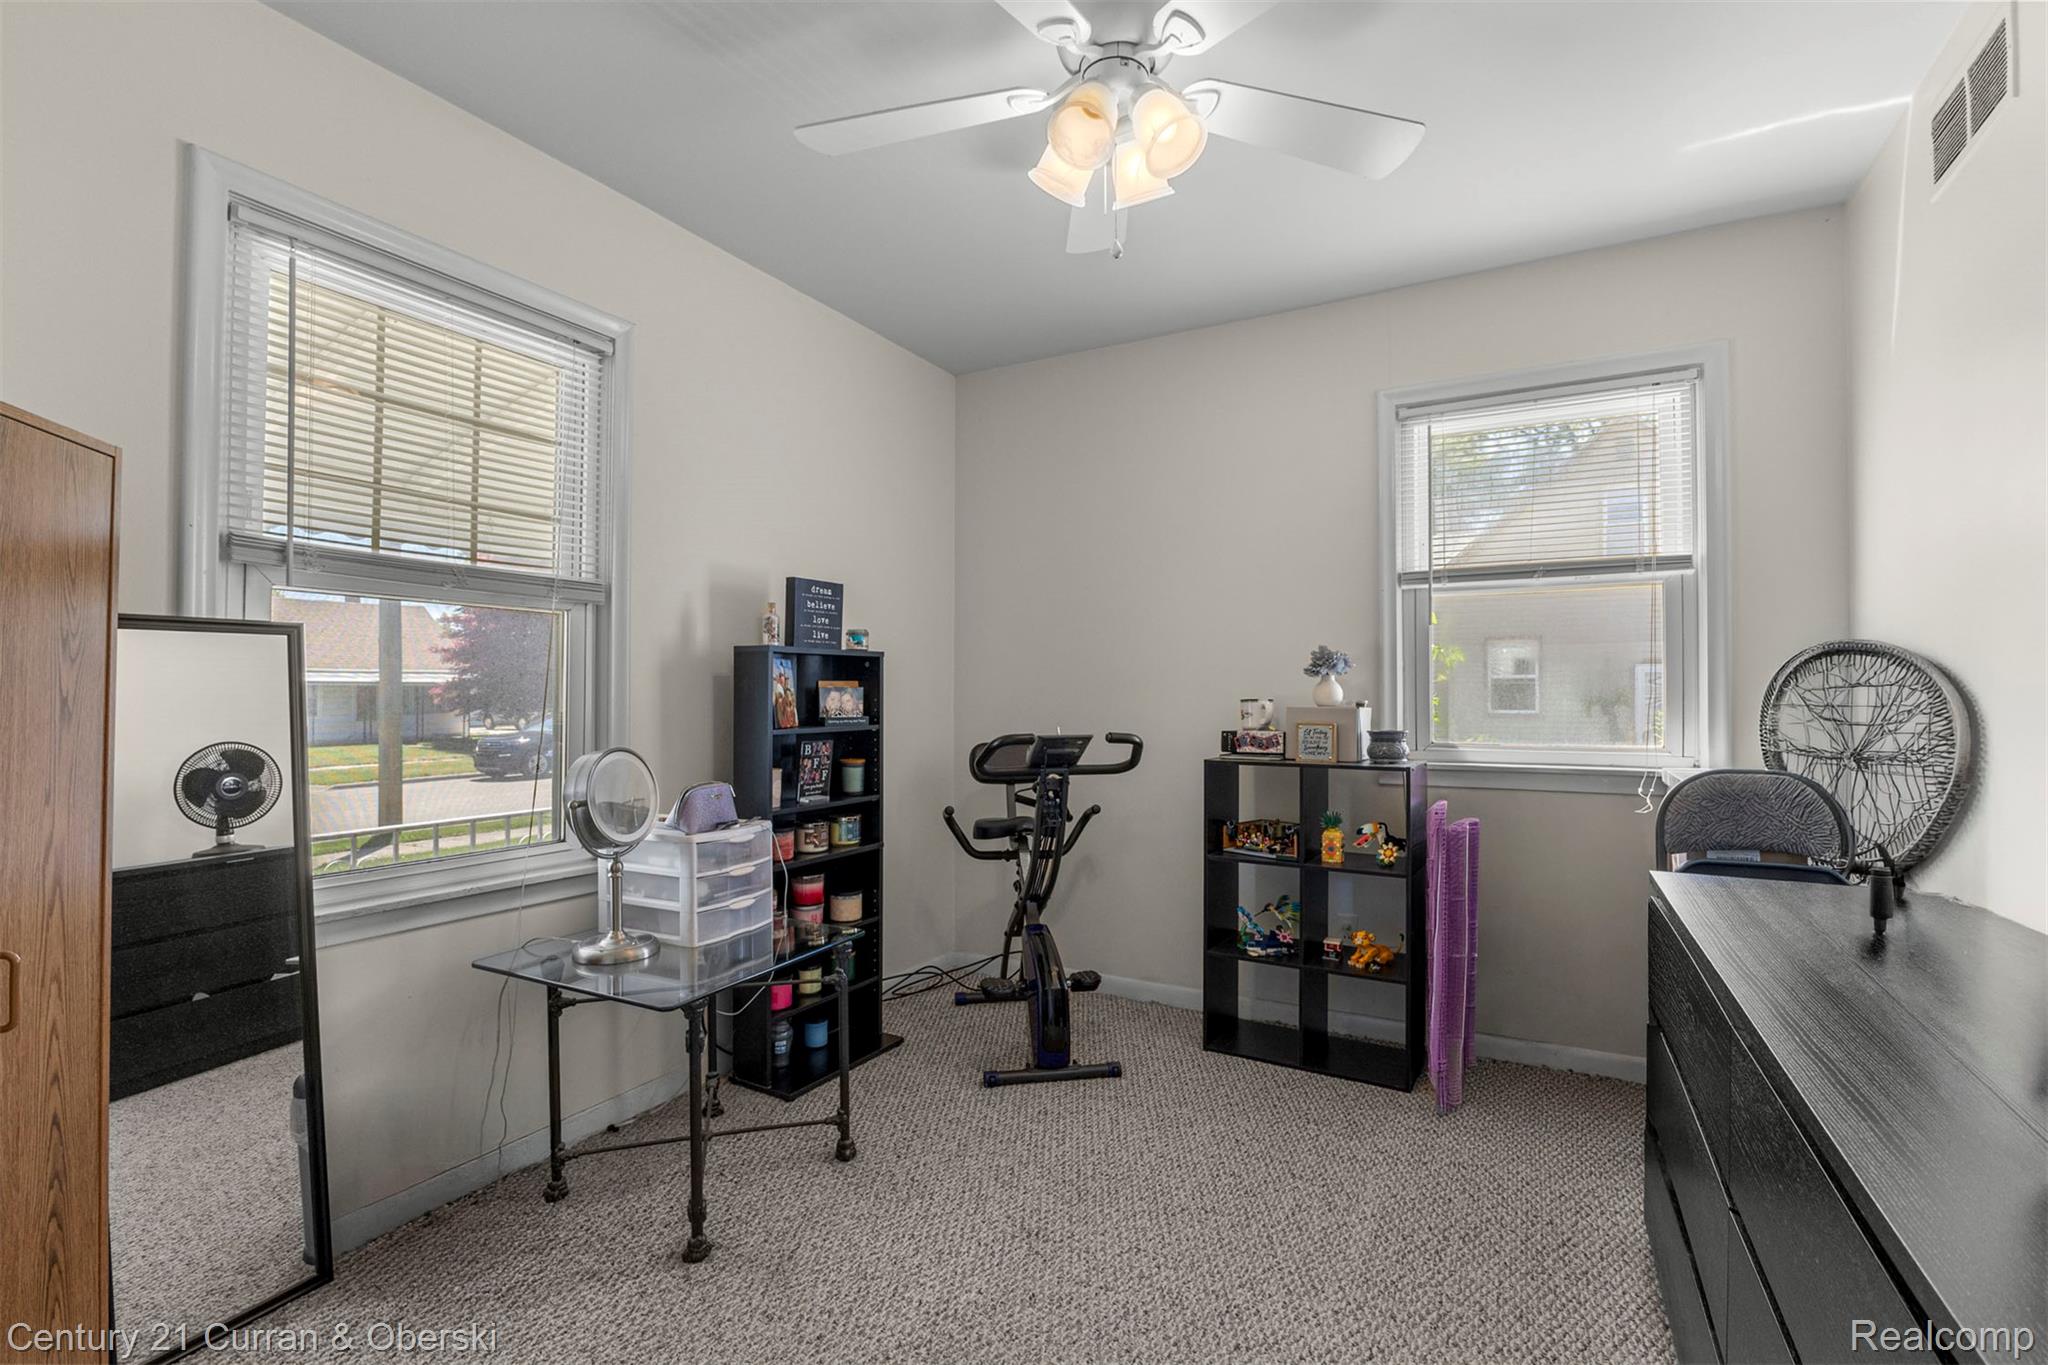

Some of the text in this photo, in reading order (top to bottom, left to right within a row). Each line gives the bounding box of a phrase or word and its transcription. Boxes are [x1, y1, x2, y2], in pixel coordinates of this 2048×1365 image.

[810, 585, 832, 595] dream
[807, 600, 835, 610] believe
[812, 615, 829, 624] love
[812, 630, 829, 639] live
[805, 745, 811, 755] B
[814, 758, 820, 768] F
[822, 769, 828, 780] F
